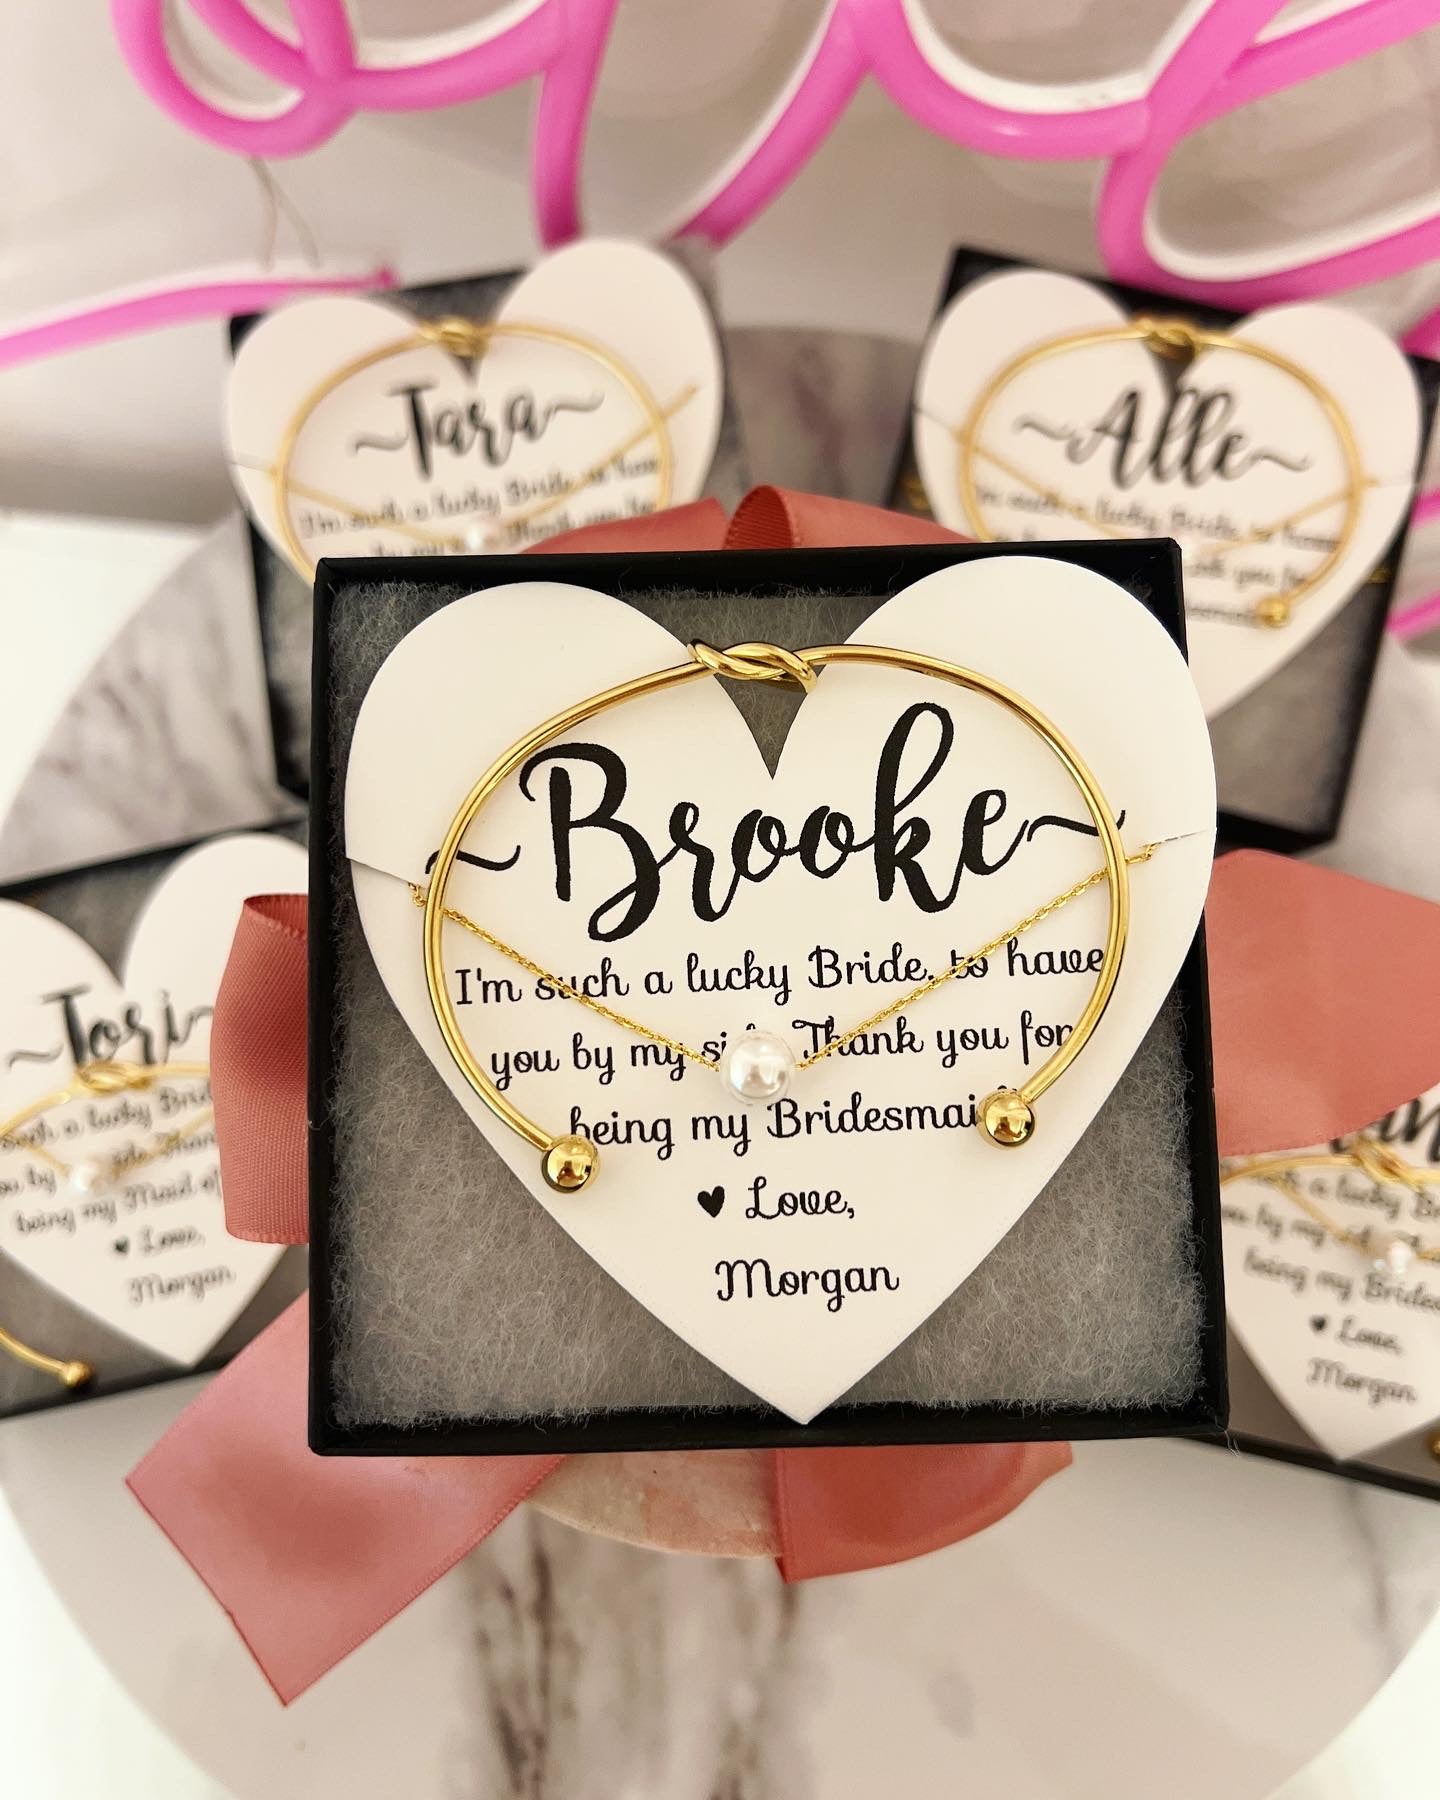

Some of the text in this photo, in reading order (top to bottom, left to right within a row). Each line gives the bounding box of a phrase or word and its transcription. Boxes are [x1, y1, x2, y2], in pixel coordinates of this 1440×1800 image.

[384, 376, 603, 482] Tara
[518, 702, 1120, 942] Brooke
[455, 967, 522, 1005] I'm
[534, 956, 630, 1000] such
[644, 970, 673, 995] a
[686, 949, 792, 1006] lucky
[950, 948, 988, 978] to
[1007, 936, 1104, 977] have
[40, 984, 208, 1065] Tori
[491, 1051, 560, 1091] you
[572, 1032, 616, 1085] by
[630, 1042, 686, 1082] my
[792, 1015, 925, 1060] Thank
[937, 1026, 1009, 1068] you
[1021, 1010, 1075, 1065] for
[570, 1090, 1008, 1160] being my Bridesmai
[745, 1176, 855, 1219] Love,
[127, 1265, 235, 1307] Morgan
[714, 1258, 900, 1313] Morgan
